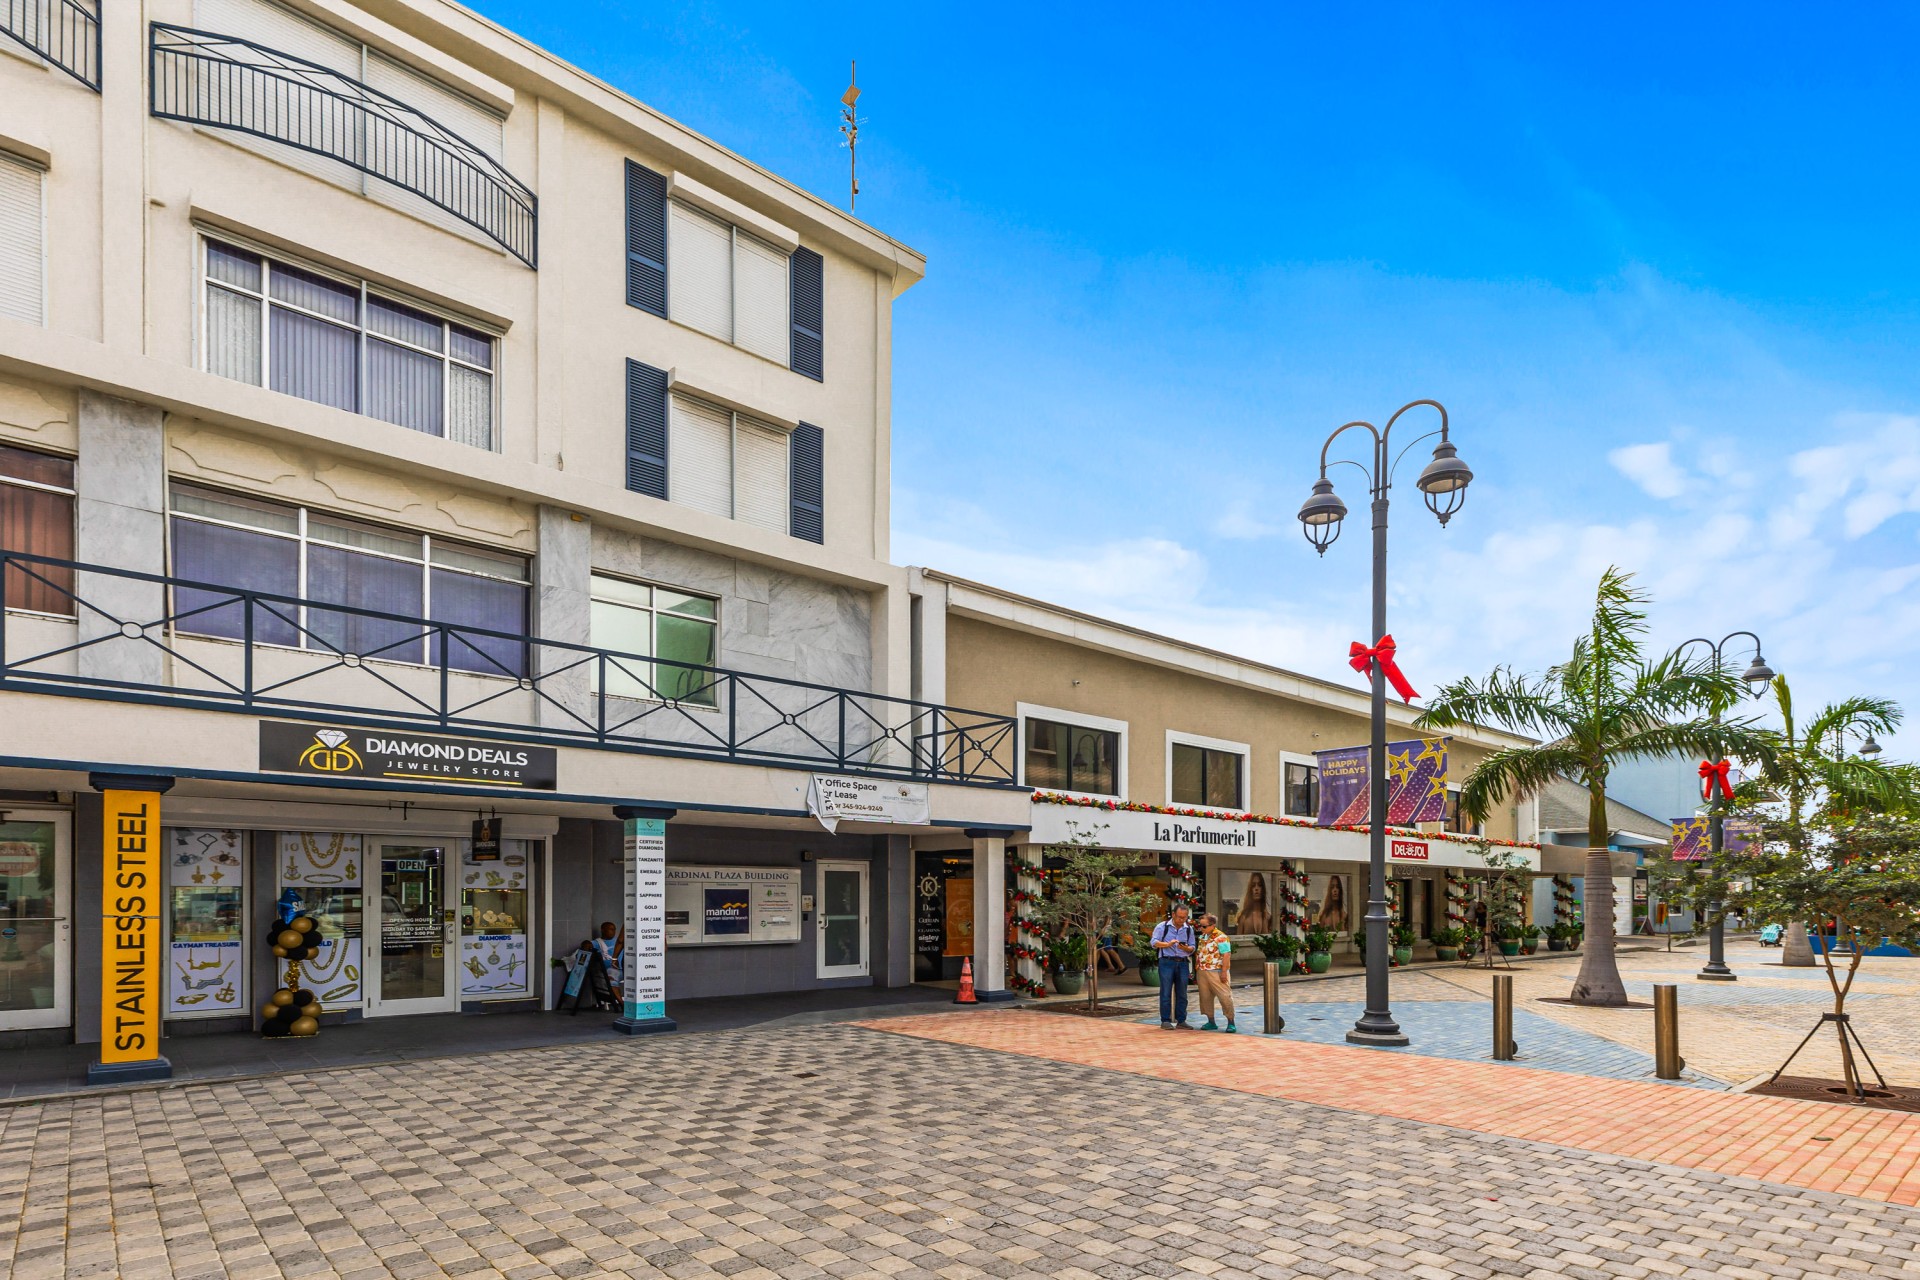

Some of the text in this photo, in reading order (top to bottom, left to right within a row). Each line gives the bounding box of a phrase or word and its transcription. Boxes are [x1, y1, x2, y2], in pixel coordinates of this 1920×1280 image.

[366, 737, 528, 766] DIAMOND DEALS
[386, 760, 521, 778] JEWELRY STORE
[1327, 759, 1359, 769] HAPPY
[1322, 766, 1366, 777] HOLIDAYS
[825, 779, 851, 789] Office
[852, 781, 878, 791] Space
[834, 791, 858, 800] Lease
[842, 802, 884, 812] 345-924-9249
[1154, 822, 1171, 842] La
[1173, 823, 1245, 847] Parfumerie
[398, 860, 425, 870] OPEN
[665, 870, 789, 880] ARDINAL PLAZA BUILDING
[705, 907, 739, 916] mandiri
[115, 803, 147, 1051] STAINLESS STEEL
